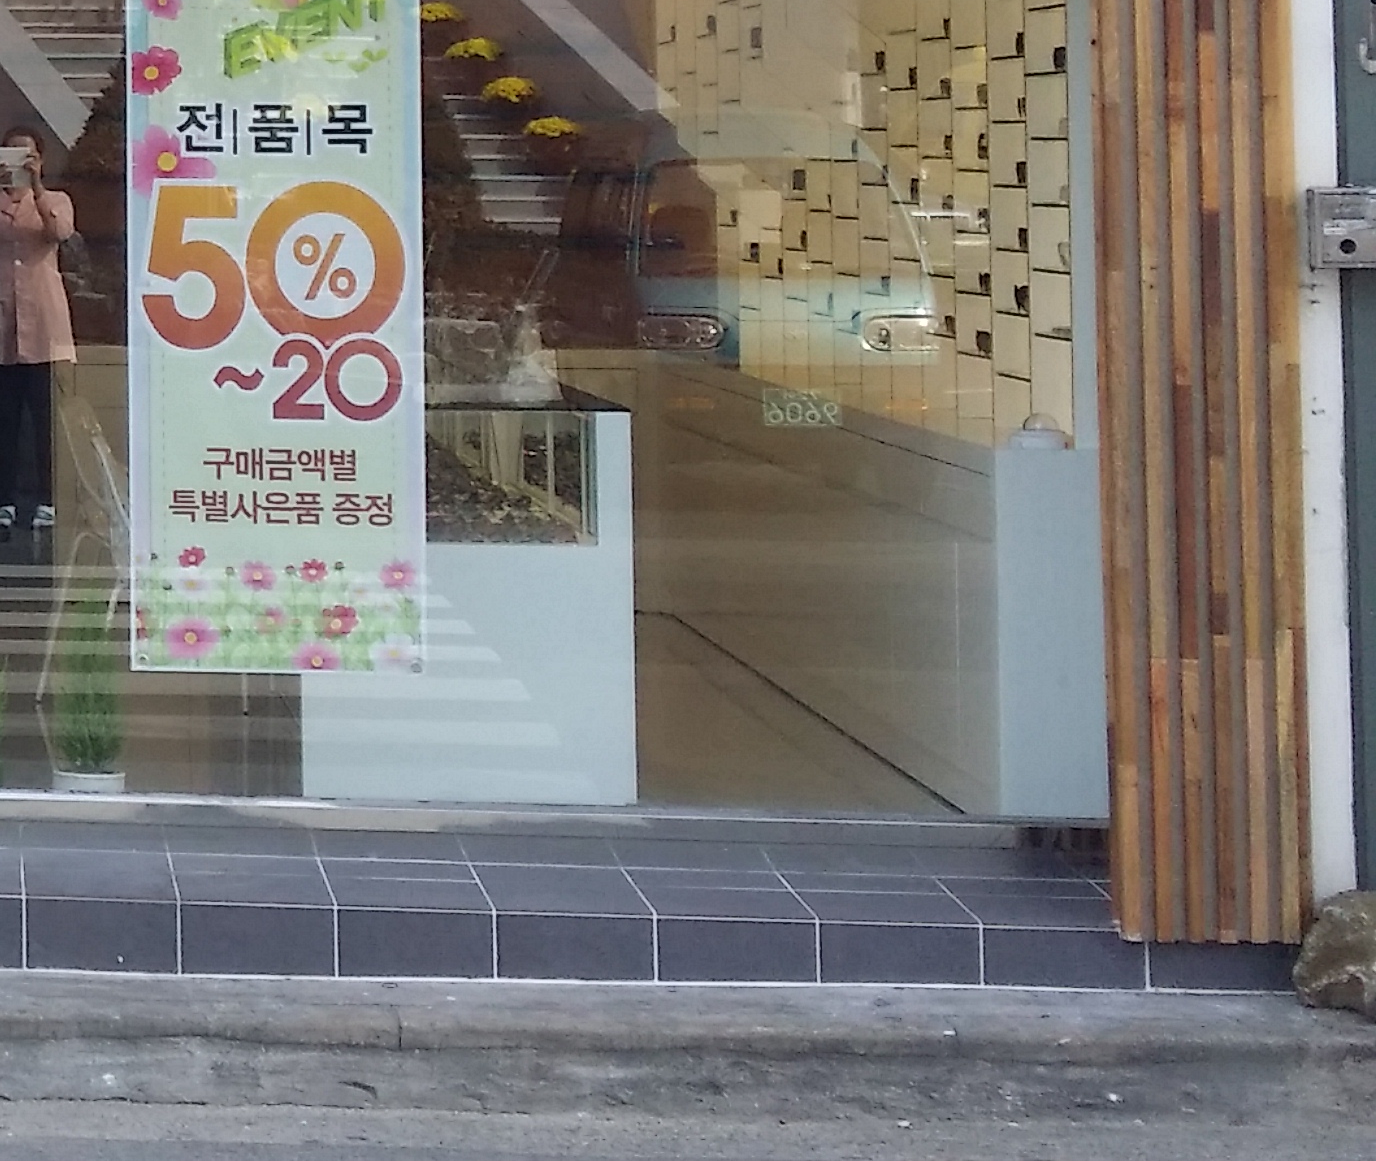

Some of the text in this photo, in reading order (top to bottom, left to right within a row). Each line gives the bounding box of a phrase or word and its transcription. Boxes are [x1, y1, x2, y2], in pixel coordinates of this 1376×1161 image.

[141, 180, 406, 350] 50%
[213, 338, 403, 422] ~20
[202, 447, 358, 482] 구매금액별
[168, 489, 395, 526] 특별사은품 증정
